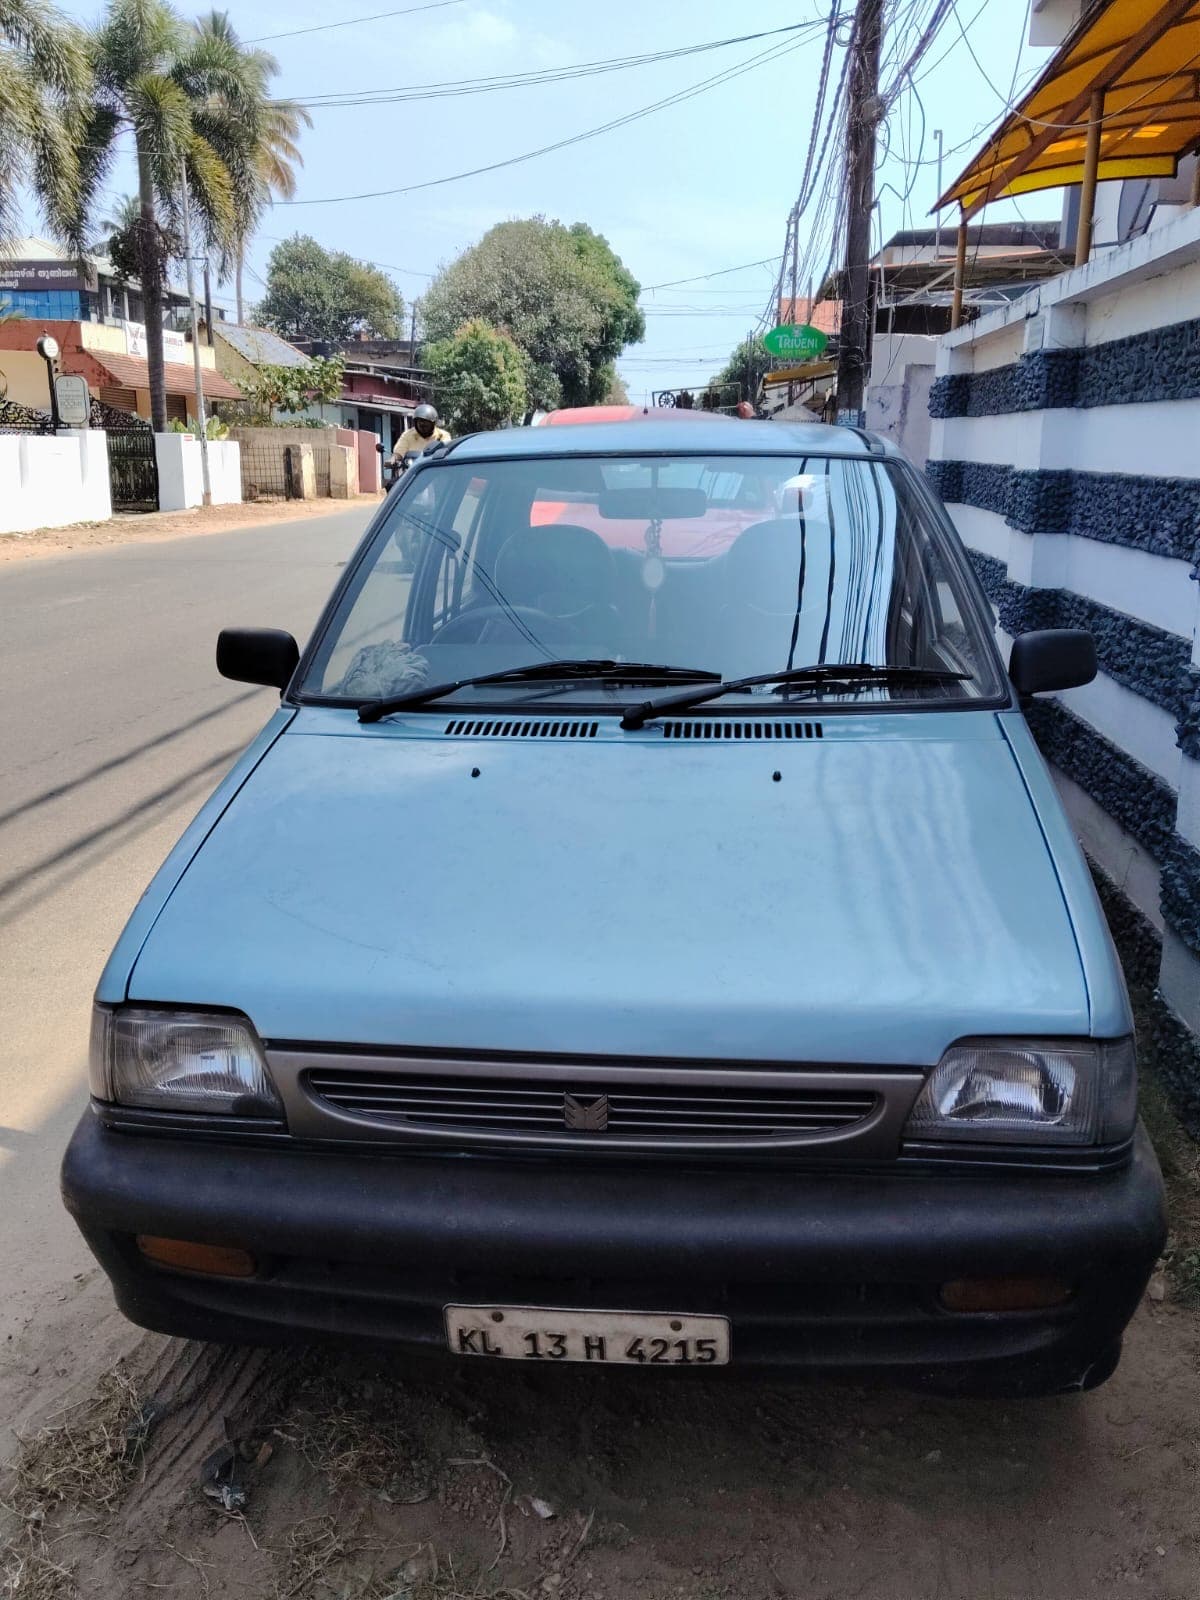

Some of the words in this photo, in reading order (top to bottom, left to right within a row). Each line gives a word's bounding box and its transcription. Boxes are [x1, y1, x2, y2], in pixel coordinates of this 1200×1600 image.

[775, 334, 818, 349] TRIVENI
[457, 1327, 500, 1354] KL
[522, 1332, 568, 1358] 13
[583, 1335, 605, 1361] H
[625, 1337, 717, 1364] 4215
